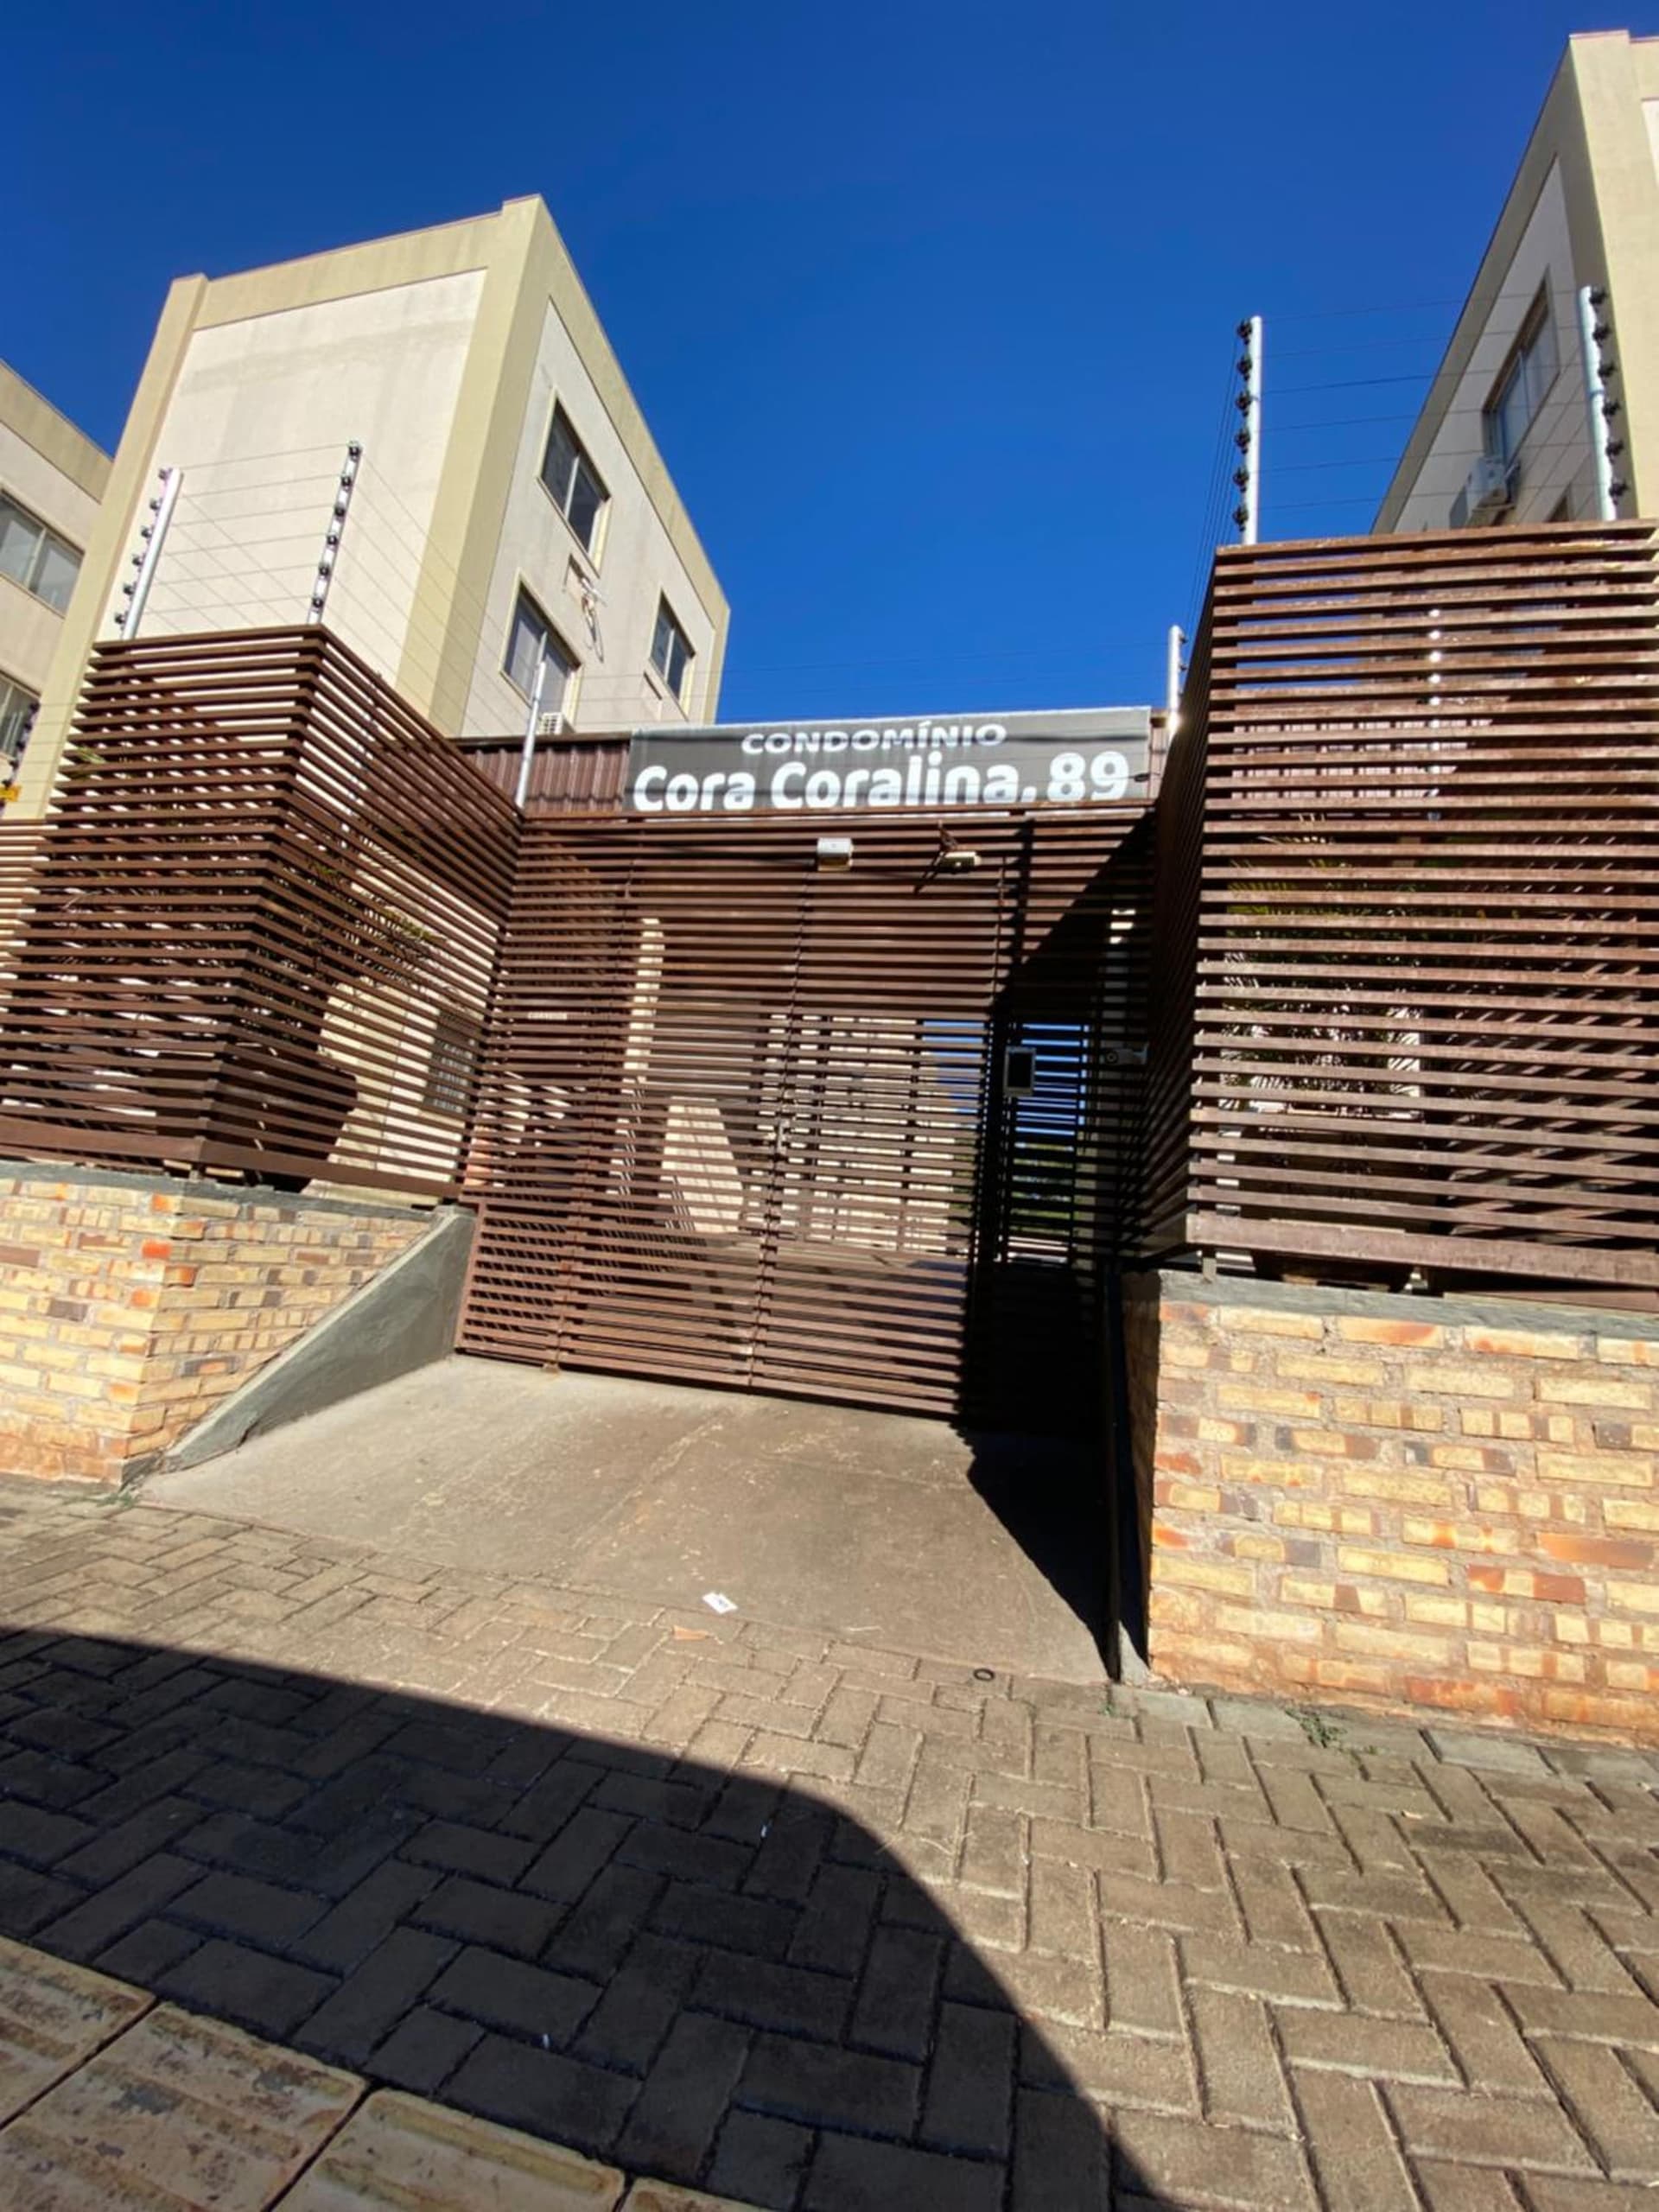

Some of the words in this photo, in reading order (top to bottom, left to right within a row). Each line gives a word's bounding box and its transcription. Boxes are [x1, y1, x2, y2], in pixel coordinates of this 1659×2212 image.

[741, 721, 1007, 754] CONDOMÍNIO
[632, 766, 754, 811] Cora
[1047, 751, 1129, 803] 89
